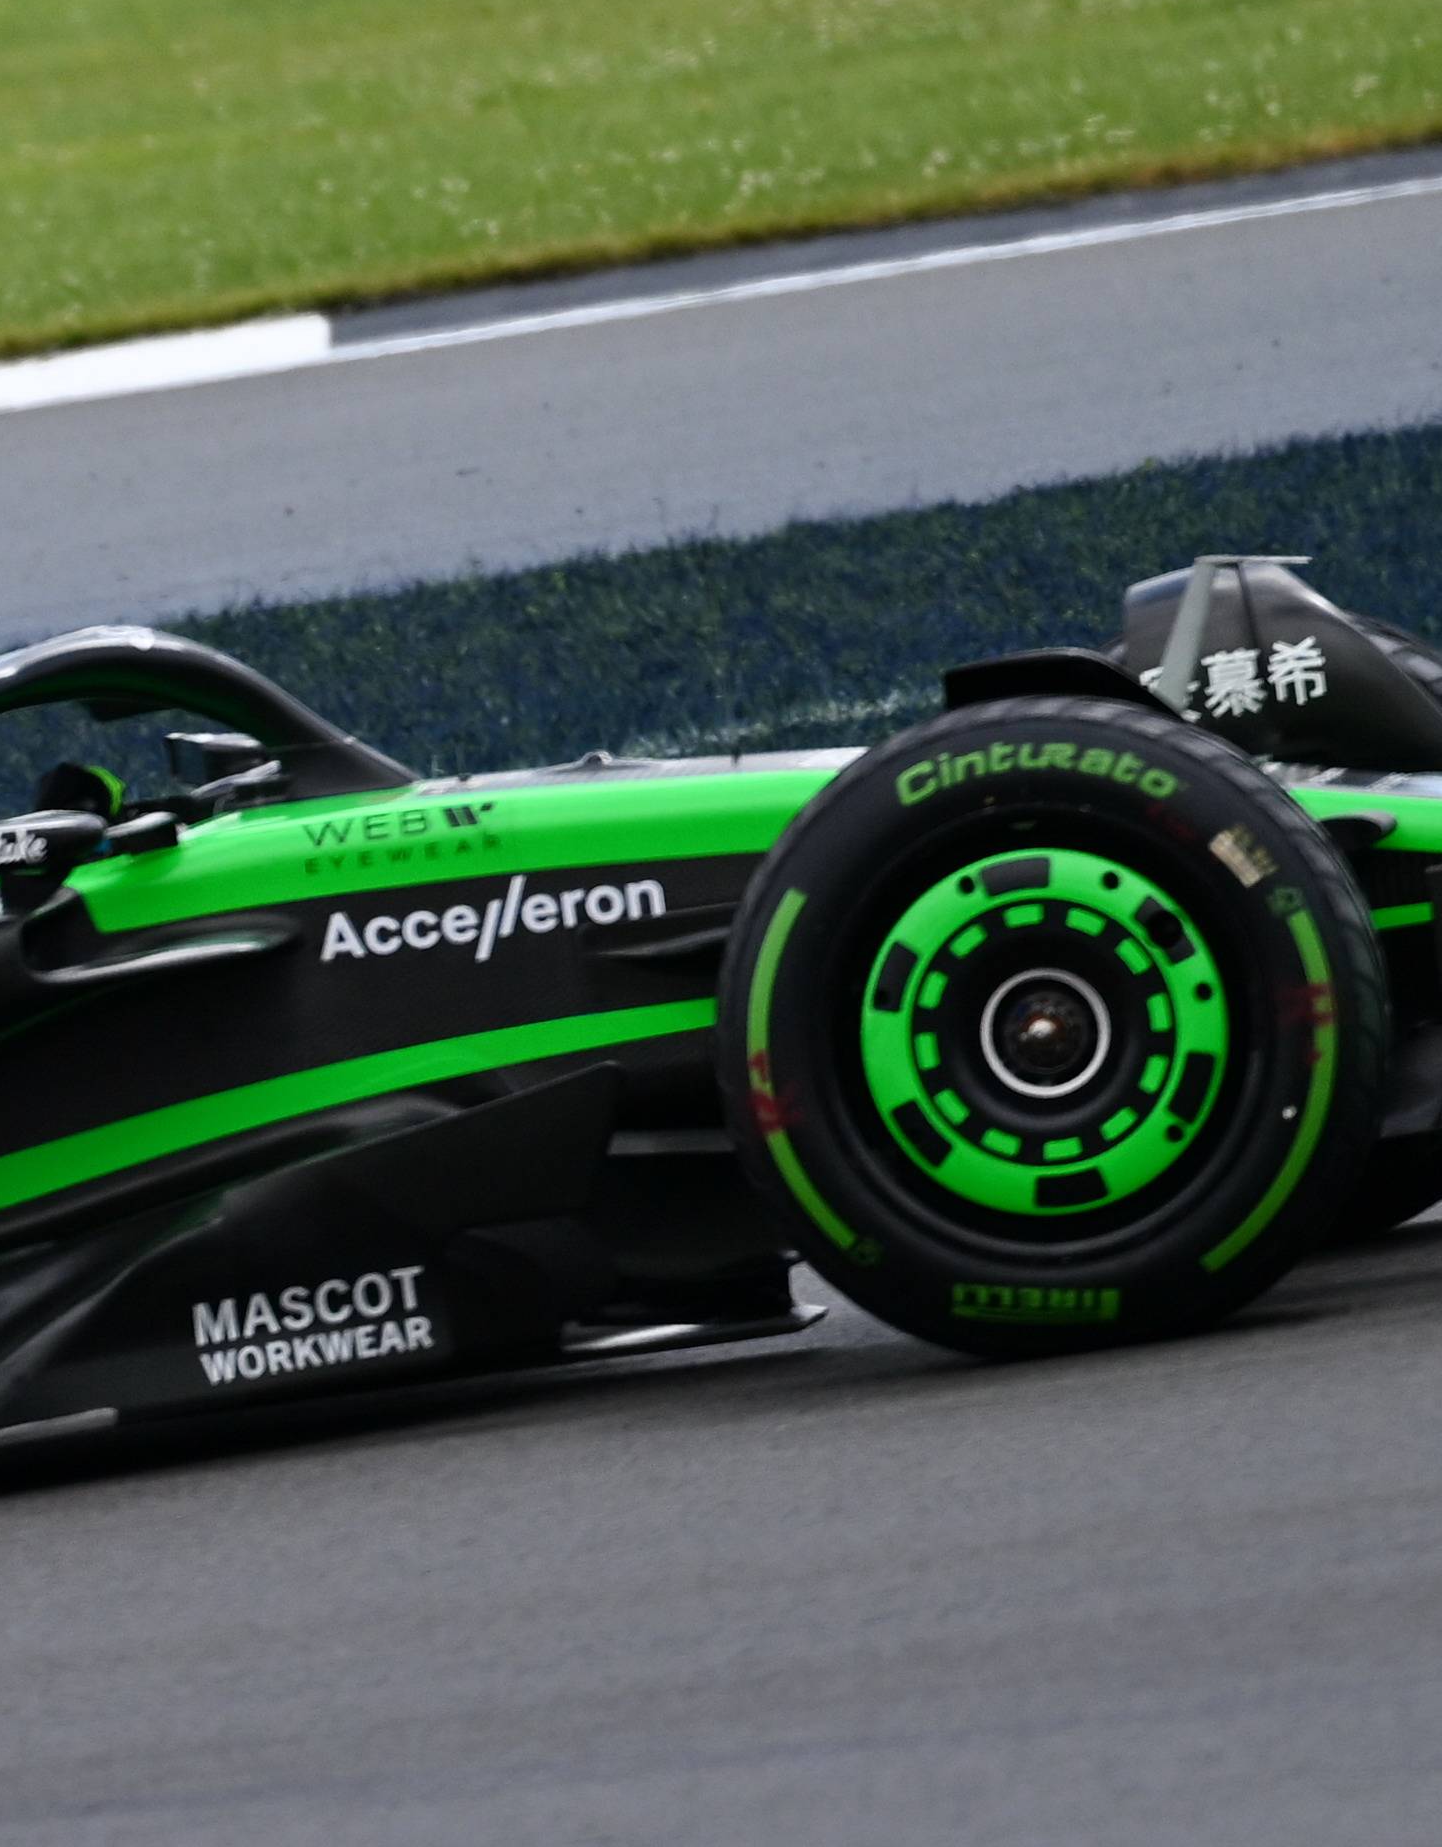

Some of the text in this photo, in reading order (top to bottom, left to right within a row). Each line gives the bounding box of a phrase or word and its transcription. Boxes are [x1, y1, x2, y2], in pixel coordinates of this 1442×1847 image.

[895, 740, 1180, 808] Cinturato
[304, 807, 427, 847] WEB
[192, 1266, 425, 1348] MASCOT
[200, 1315, 433, 1386] WORKWEAR
